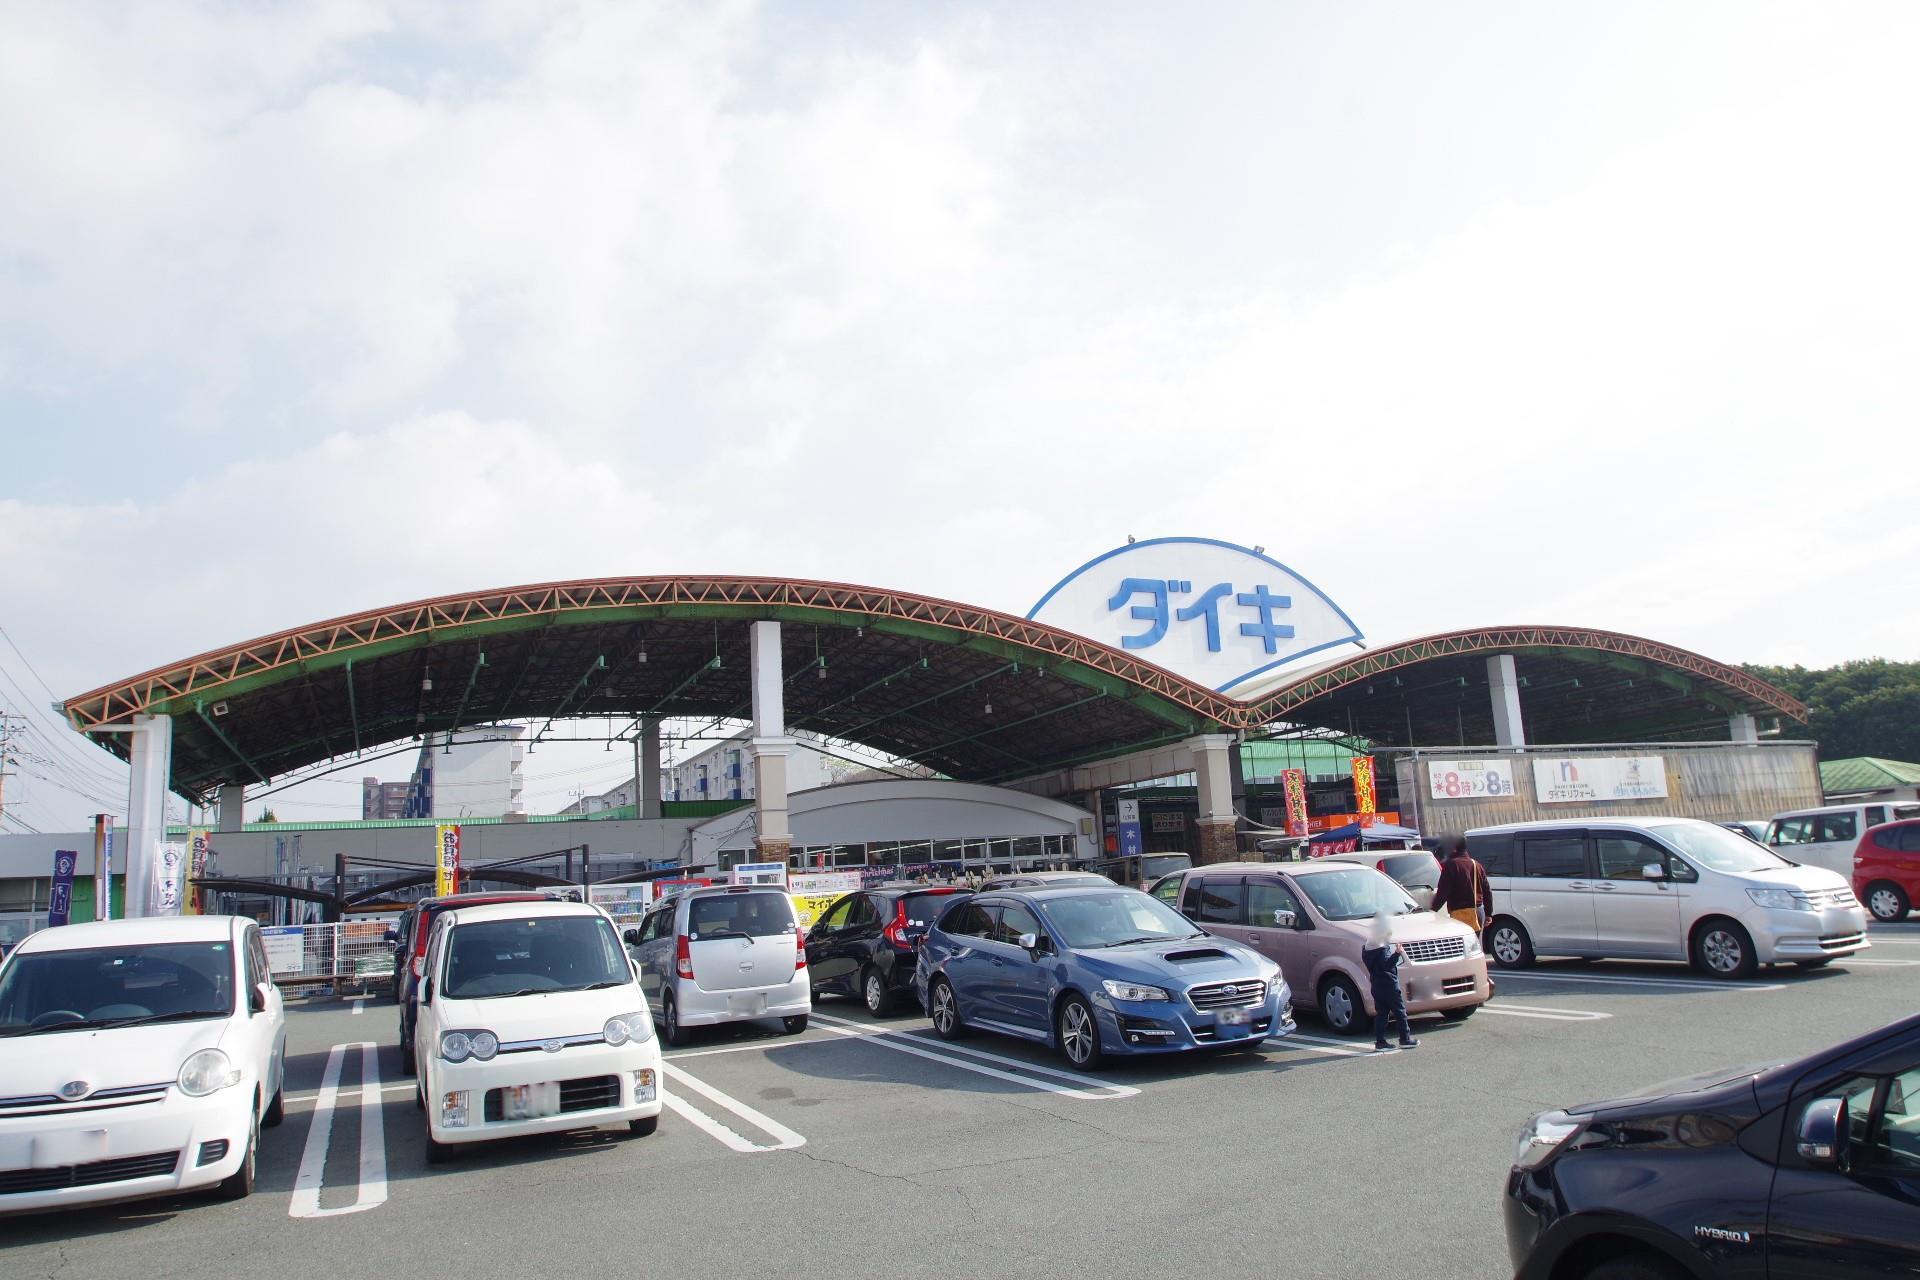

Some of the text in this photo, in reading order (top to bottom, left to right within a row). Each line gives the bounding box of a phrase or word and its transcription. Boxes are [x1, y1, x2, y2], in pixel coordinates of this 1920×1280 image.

[1108, 577, 1296, 655] ダイキ
[1356, 760, 1375, 813] 天津甘栗
[1548, 788, 1597, 800] ダイキリフォーム
[1126, 829, 1137, 855] 木材
[1311, 840, 1356, 857] あまぐり
[860, 866, 894, 879] Christmas
[1694, 1225, 1742, 1242] HYBRID
